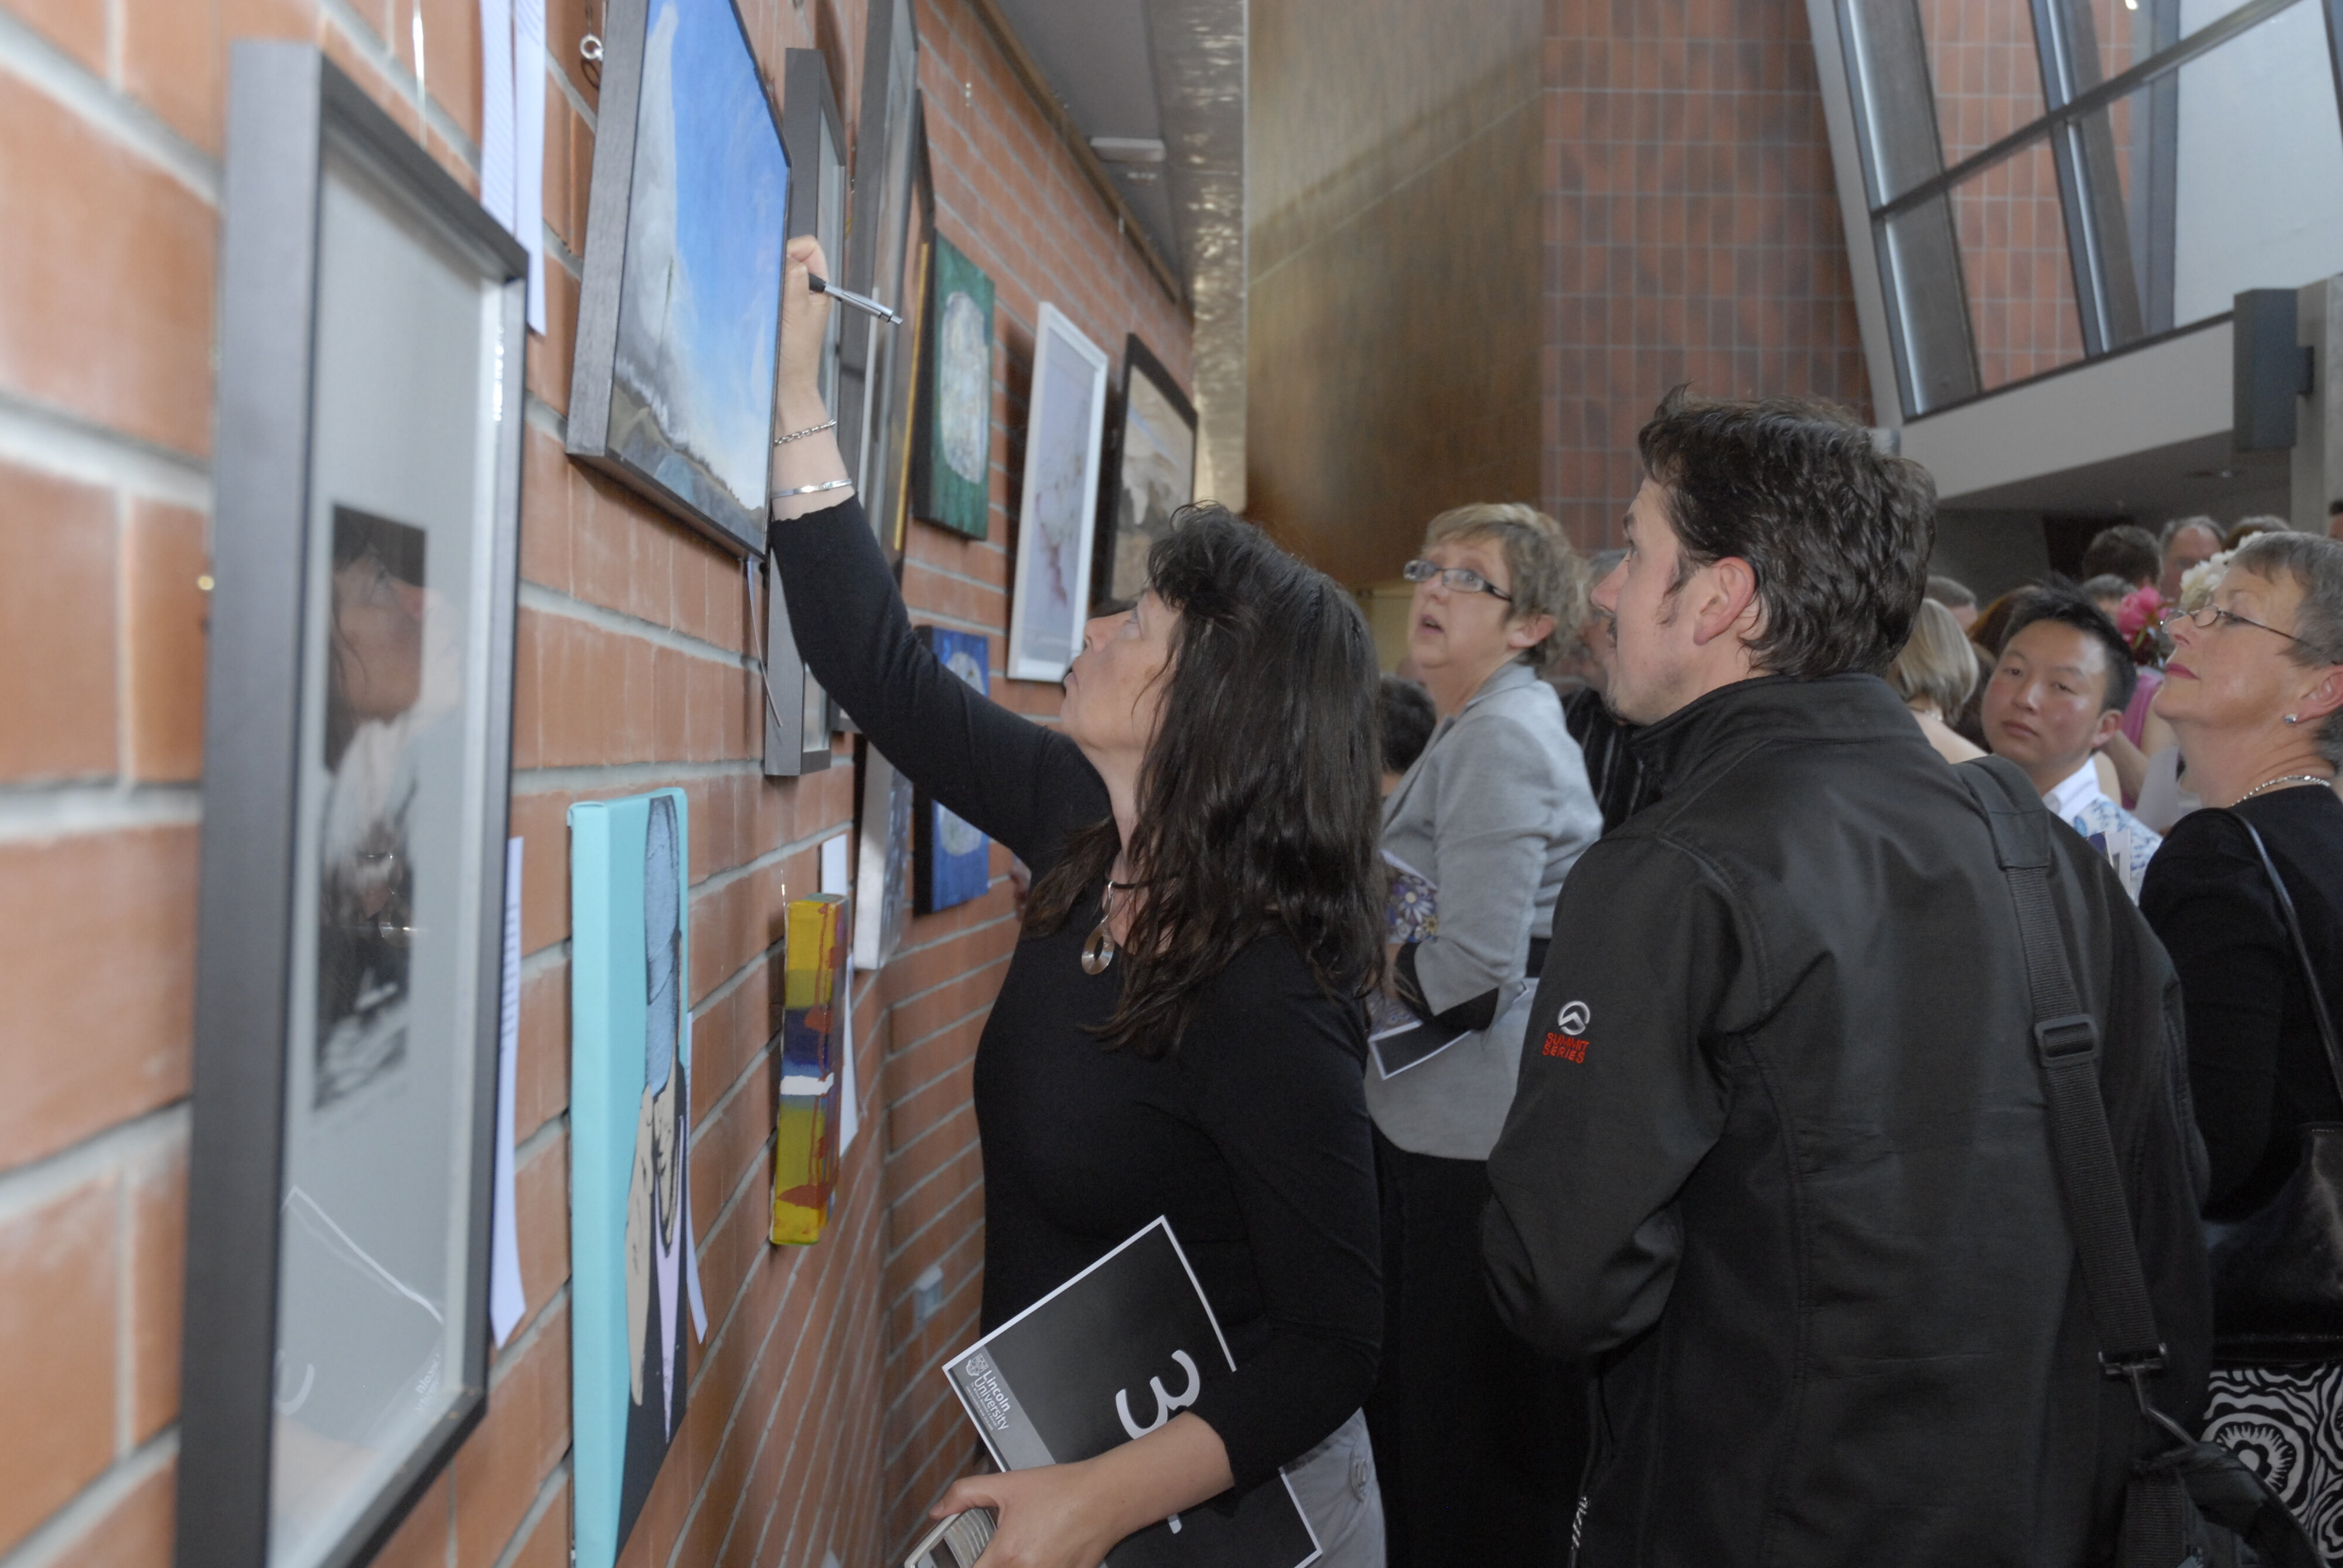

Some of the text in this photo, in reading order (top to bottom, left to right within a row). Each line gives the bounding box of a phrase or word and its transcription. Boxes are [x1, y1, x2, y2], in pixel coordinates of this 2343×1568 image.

[1542, 1043, 1585, 1064] SERIES
[1546, 1033, 1590, 1052] SUMMIT
[974, 1376, 1009, 1430] University
[983, 1370, 1011, 1412] Lincoln
